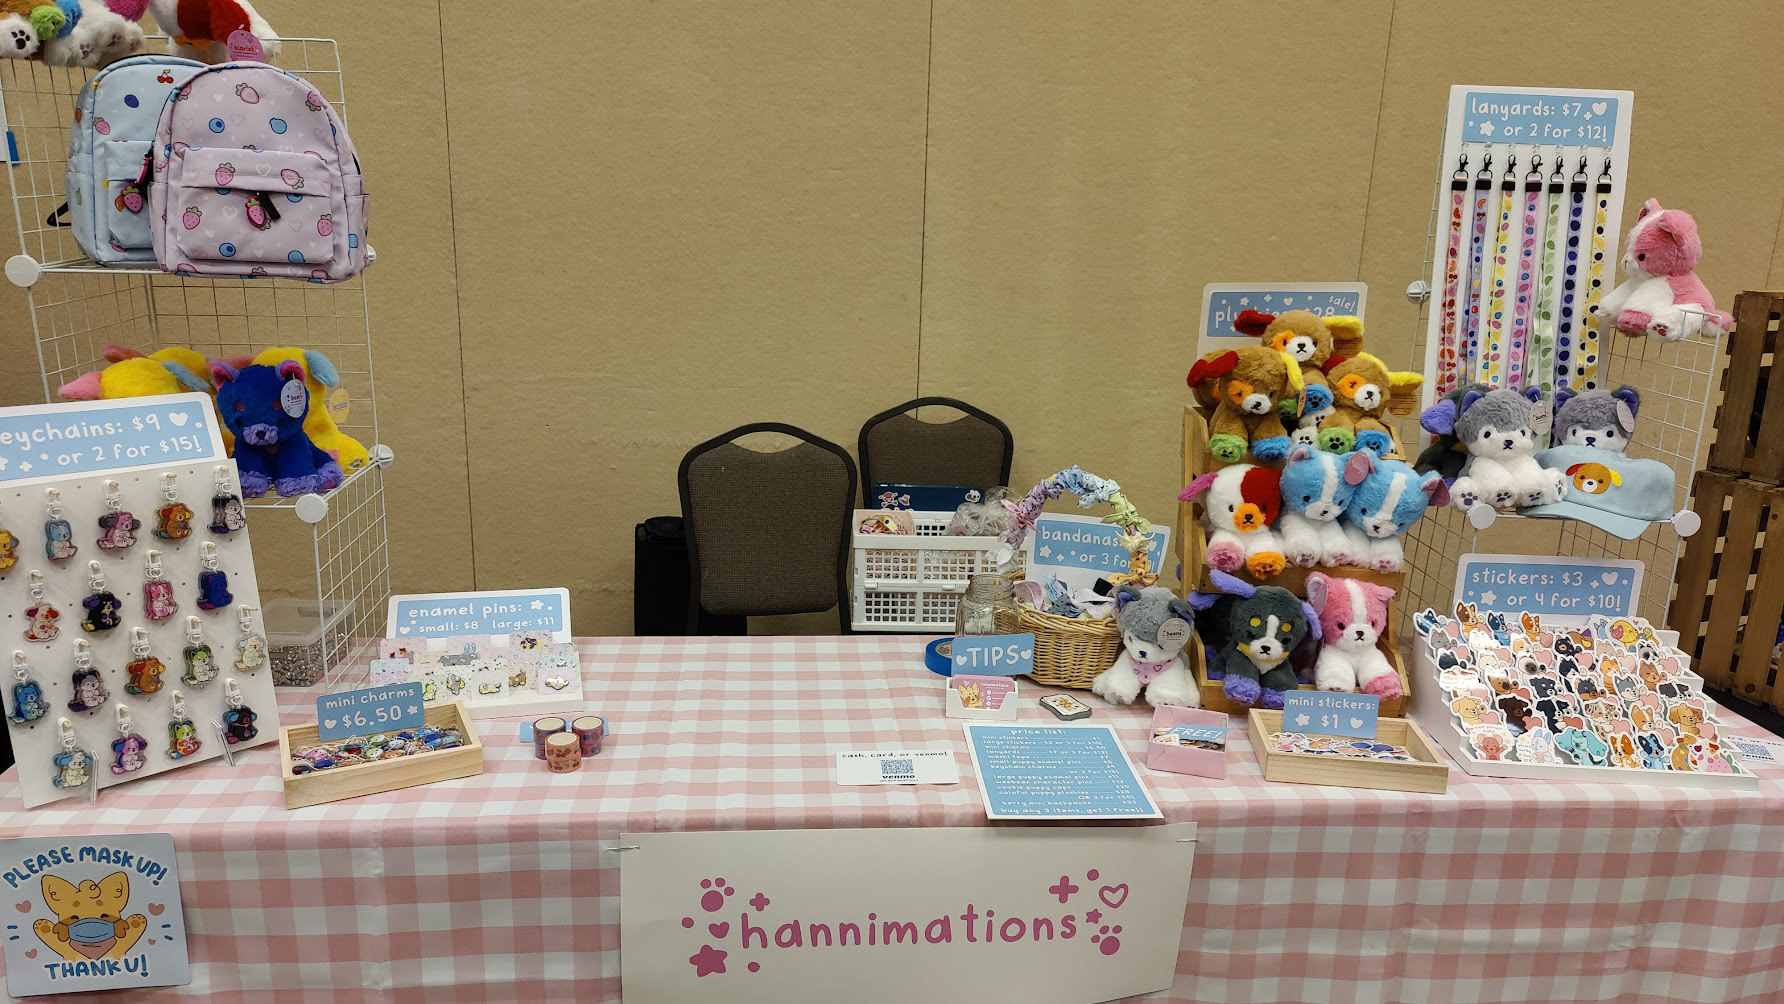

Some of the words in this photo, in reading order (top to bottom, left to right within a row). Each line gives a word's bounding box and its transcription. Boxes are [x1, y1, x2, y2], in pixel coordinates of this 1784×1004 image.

[1471, 97, 1556, 121] lanyards:
[1562, 102, 1582, 117] $7
[1503, 125, 1523, 137] or
[1529, 123, 1538, 137] 2
[1543, 123, 1571, 138] for
[1577, 125, 1608, 143] $12!
[1328, 295, 1356, 313] sale!
[0, 421, 124, 451] eychains:
[132, 413, 161, 432] $9
[57, 451, 83, 466] or
[91, 446, 106, 462] 2
[113, 444, 151, 459] for
[159, 435, 203, 454] $15!
[1041, 525, 1122, 548] bandanas
[1079, 552, 1096, 563] or
[1101, 552, 1111, 565] 3
[1472, 567, 1554, 585] stickers:
[1562, 571, 1584, 587] $3
[408, 603, 474, 618] enamel
[482, 603, 523, 619] pins:
[1506, 594, 1528, 606] or
[1534, 592, 1545, 606] 4
[1551, 592, 1581, 608] for
[1587, 594, 1622, 612] $10!
[419, 621, 459, 633] small:
[463, 620, 479, 631] $8
[491, 619, 533, 630] large:
[536, 617, 555, 627] $11
[966, 644, 1019, 668] TIPS
[326, 695, 355, 709] mini
[360, 688, 415, 704] charms
[1288, 696, 1315, 707] mini
[1318, 697, 1376, 711] stickers:
[342, 705, 402, 729] $6.50
[1320, 714, 1339, 729] $1
[1169, 726, 1225, 740] FREE!
[1000, 807, 1020, 815] buy
[3, 846, 75, 889] PLEASE
[79, 846, 135, 868] MASK
[136, 856, 168, 886] UP!
[740, 903, 1078, 949] hannimations
[44, 959, 122, 980] THANK
[124, 953, 149, 978] U!
